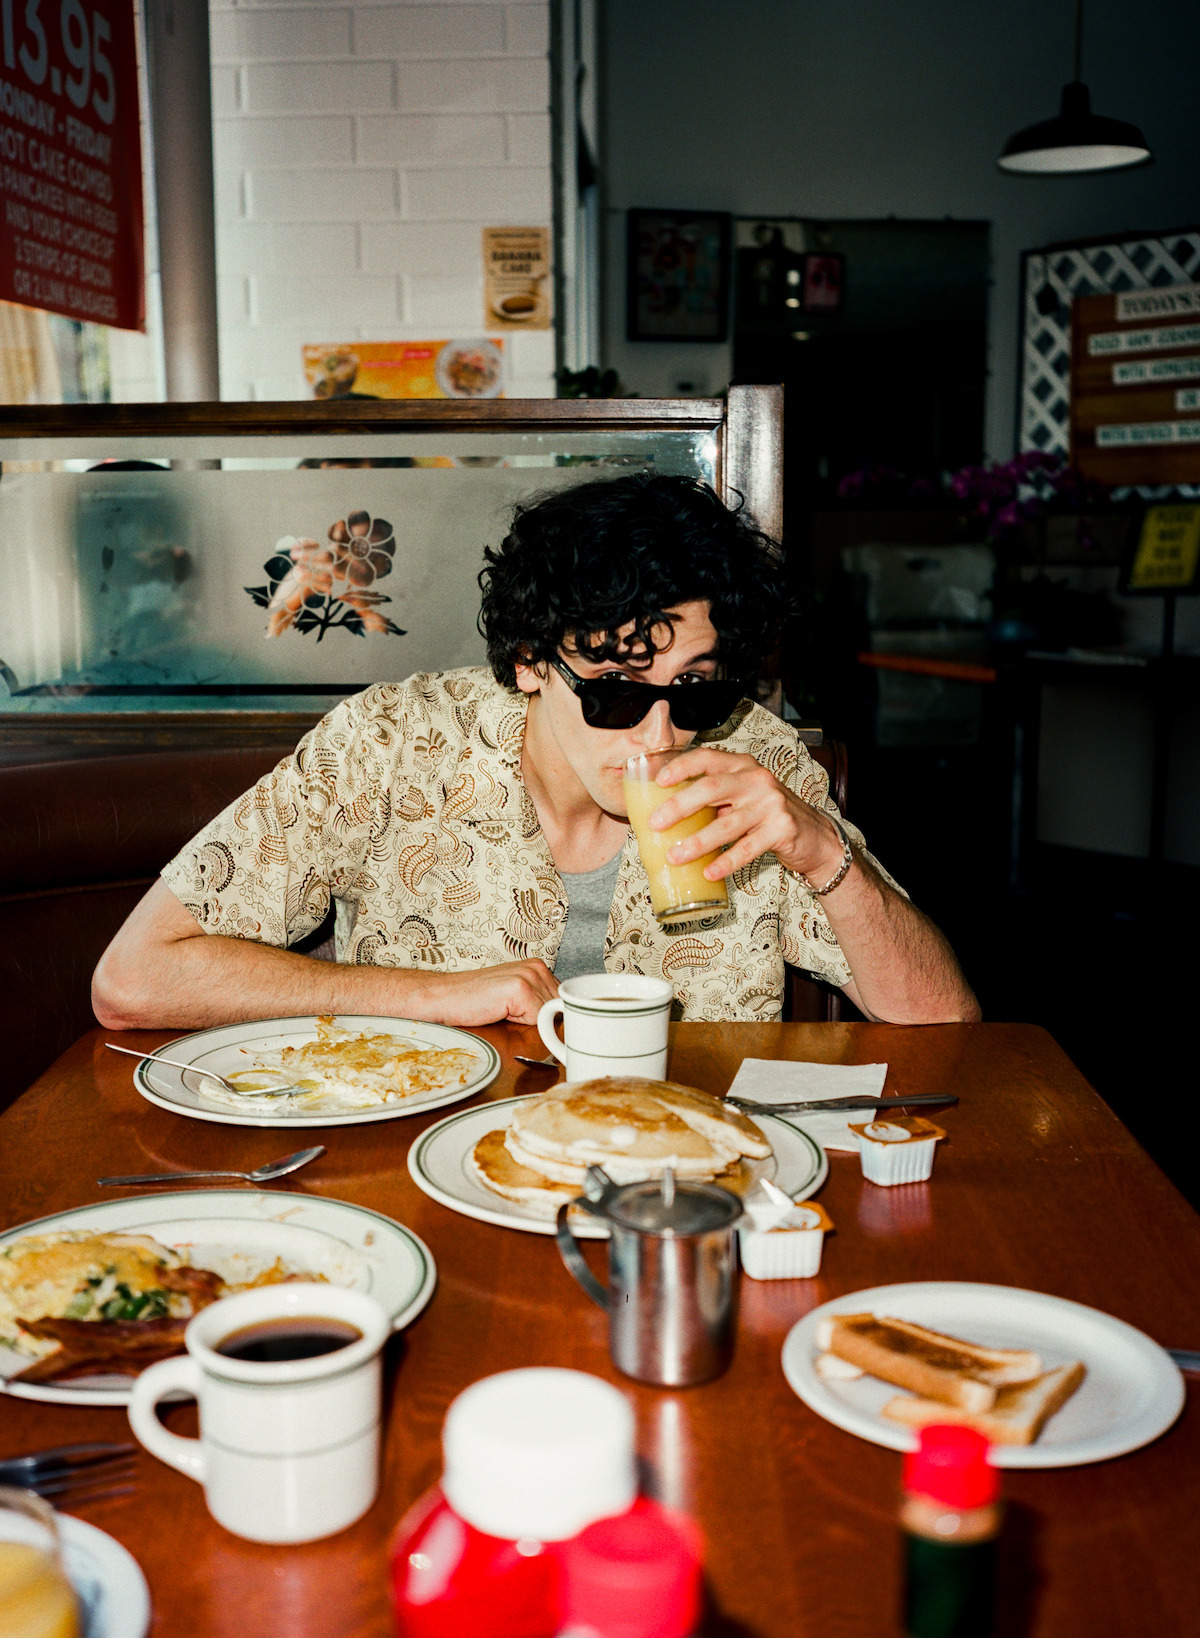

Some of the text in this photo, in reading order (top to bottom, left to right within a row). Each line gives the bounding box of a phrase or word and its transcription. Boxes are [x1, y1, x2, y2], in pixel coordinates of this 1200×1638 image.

[28, 138, 66, 182] CAKE
[66, 114, 112, 166] FRIDAY
[4, 165, 64, 212] PANCAKES
[6, 200, 29, 231] AND
[31, 209, 61, 242] YOUR
[22, 239, 60, 274] STRIPS
[61, 251, 77, 277] OF
[79, 257, 113, 290] BACON
[491, 251, 542, 261] BANANA
[501, 263, 532, 274] CAKE
[14, 267, 30, 296] OR
